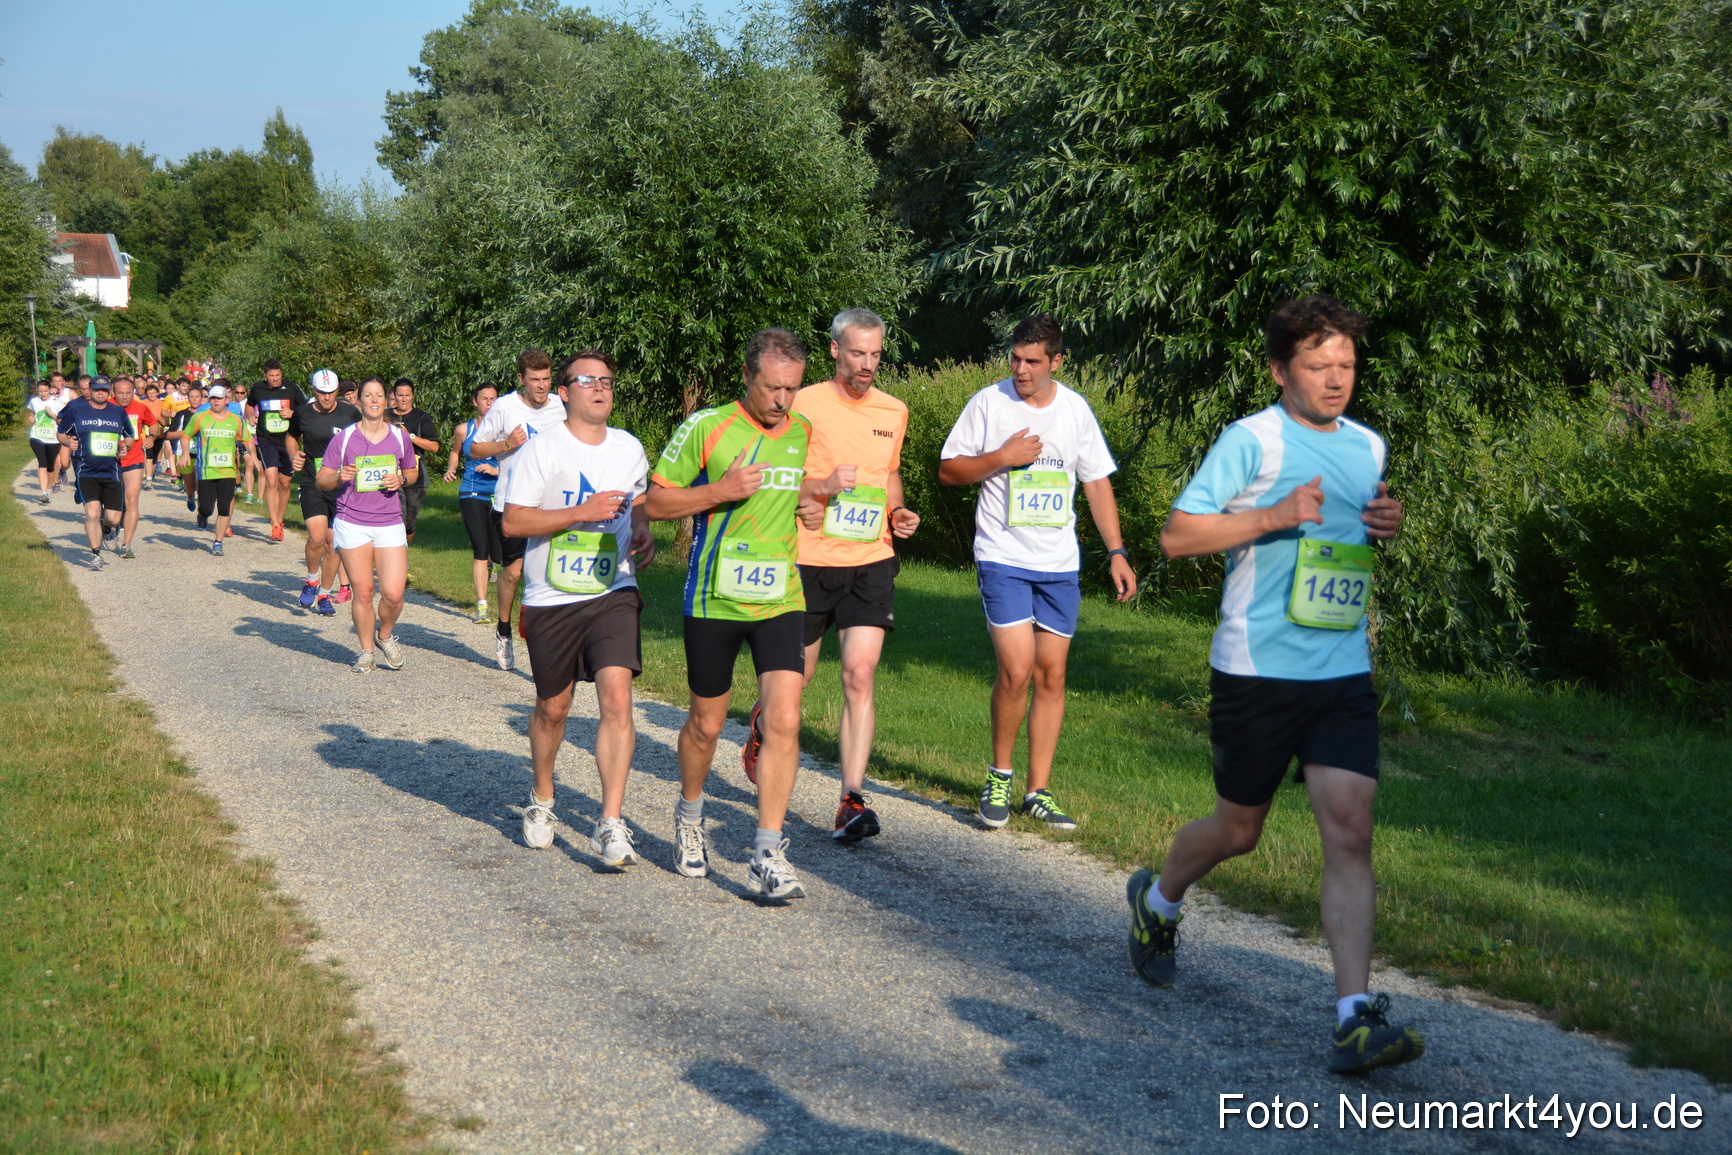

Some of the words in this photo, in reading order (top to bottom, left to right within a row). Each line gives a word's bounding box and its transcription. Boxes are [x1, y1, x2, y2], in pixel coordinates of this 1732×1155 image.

[273, 420, 283, 428] 37
[204, 428, 237, 438] BOCK
[872, 429, 894, 439] THULE
[97, 441, 113, 450] 369
[213, 454, 228, 462] 143
[1017, 493, 1063, 511] 1470
[833, 505, 880, 527] 1447
[557, 555, 611, 577] 1479
[734, 565, 776, 587] 145
[1305, 575, 1364, 607] 1432
